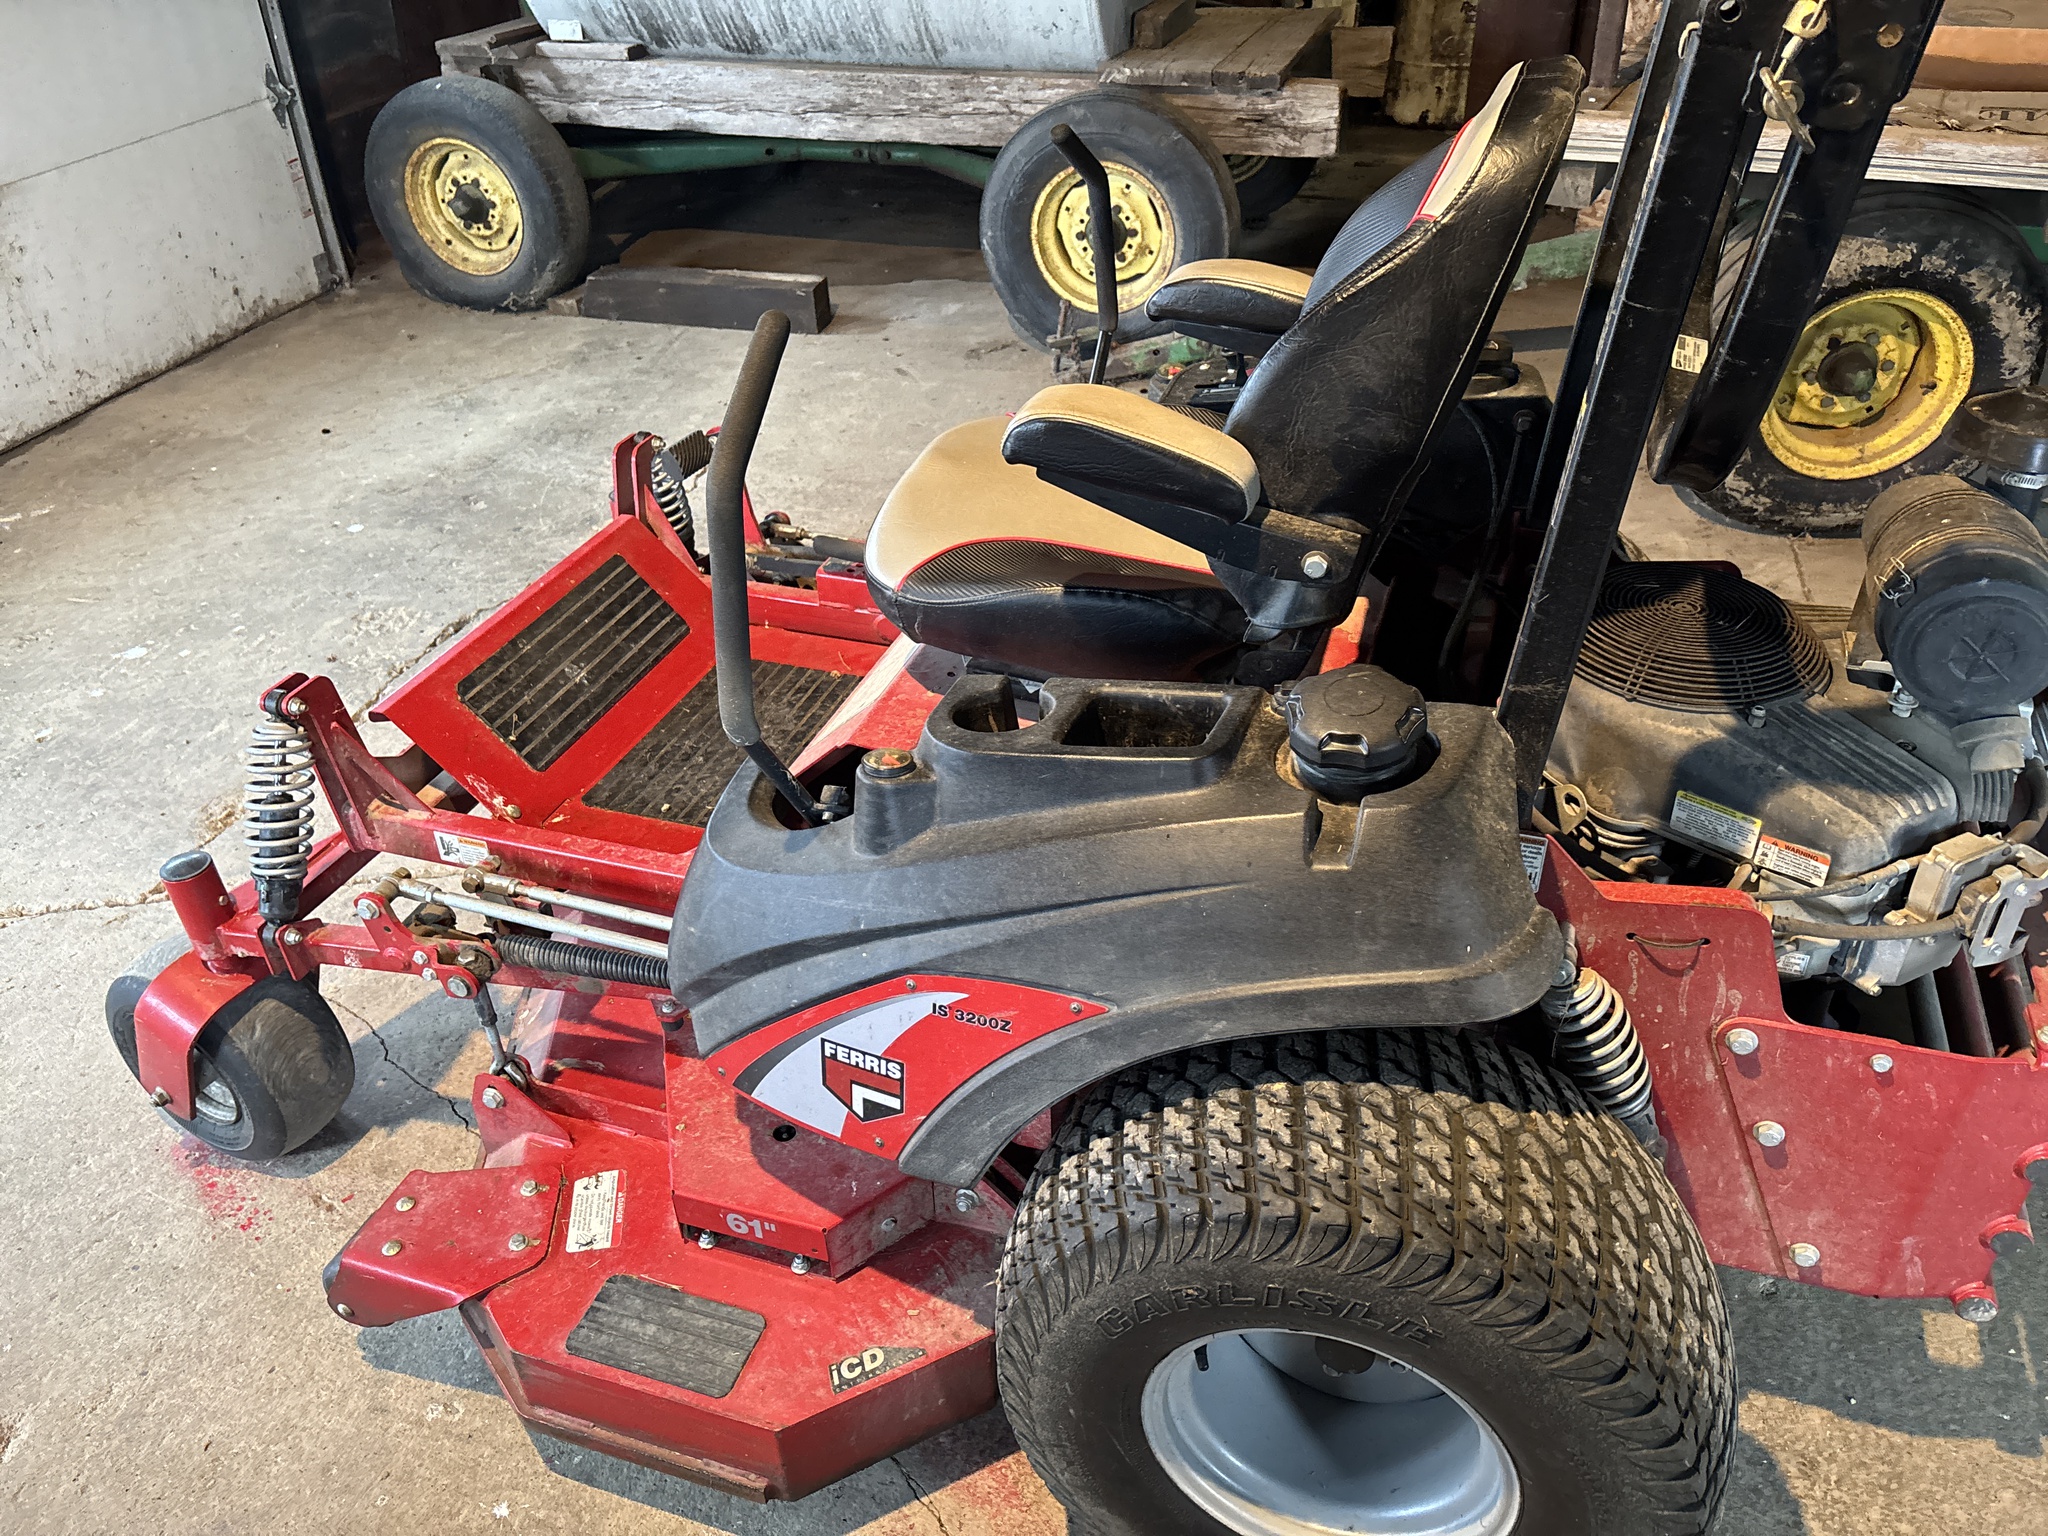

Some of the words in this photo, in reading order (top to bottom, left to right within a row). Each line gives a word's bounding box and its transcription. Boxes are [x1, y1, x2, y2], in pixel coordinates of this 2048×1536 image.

[1784, 844, 1819, 862] WARNING
[932, 1002, 949, 1017] IS
[954, 1009, 1012, 1033] 3200Z
[824, 1041, 902, 1080] FERRIS
[615, 1198, 625, 1224] DANGER
[726, 1213, 777, 1239] 61"
[1095, 1281, 1445, 1349] CARLISLE
[830, 1347, 885, 1386] iCD
